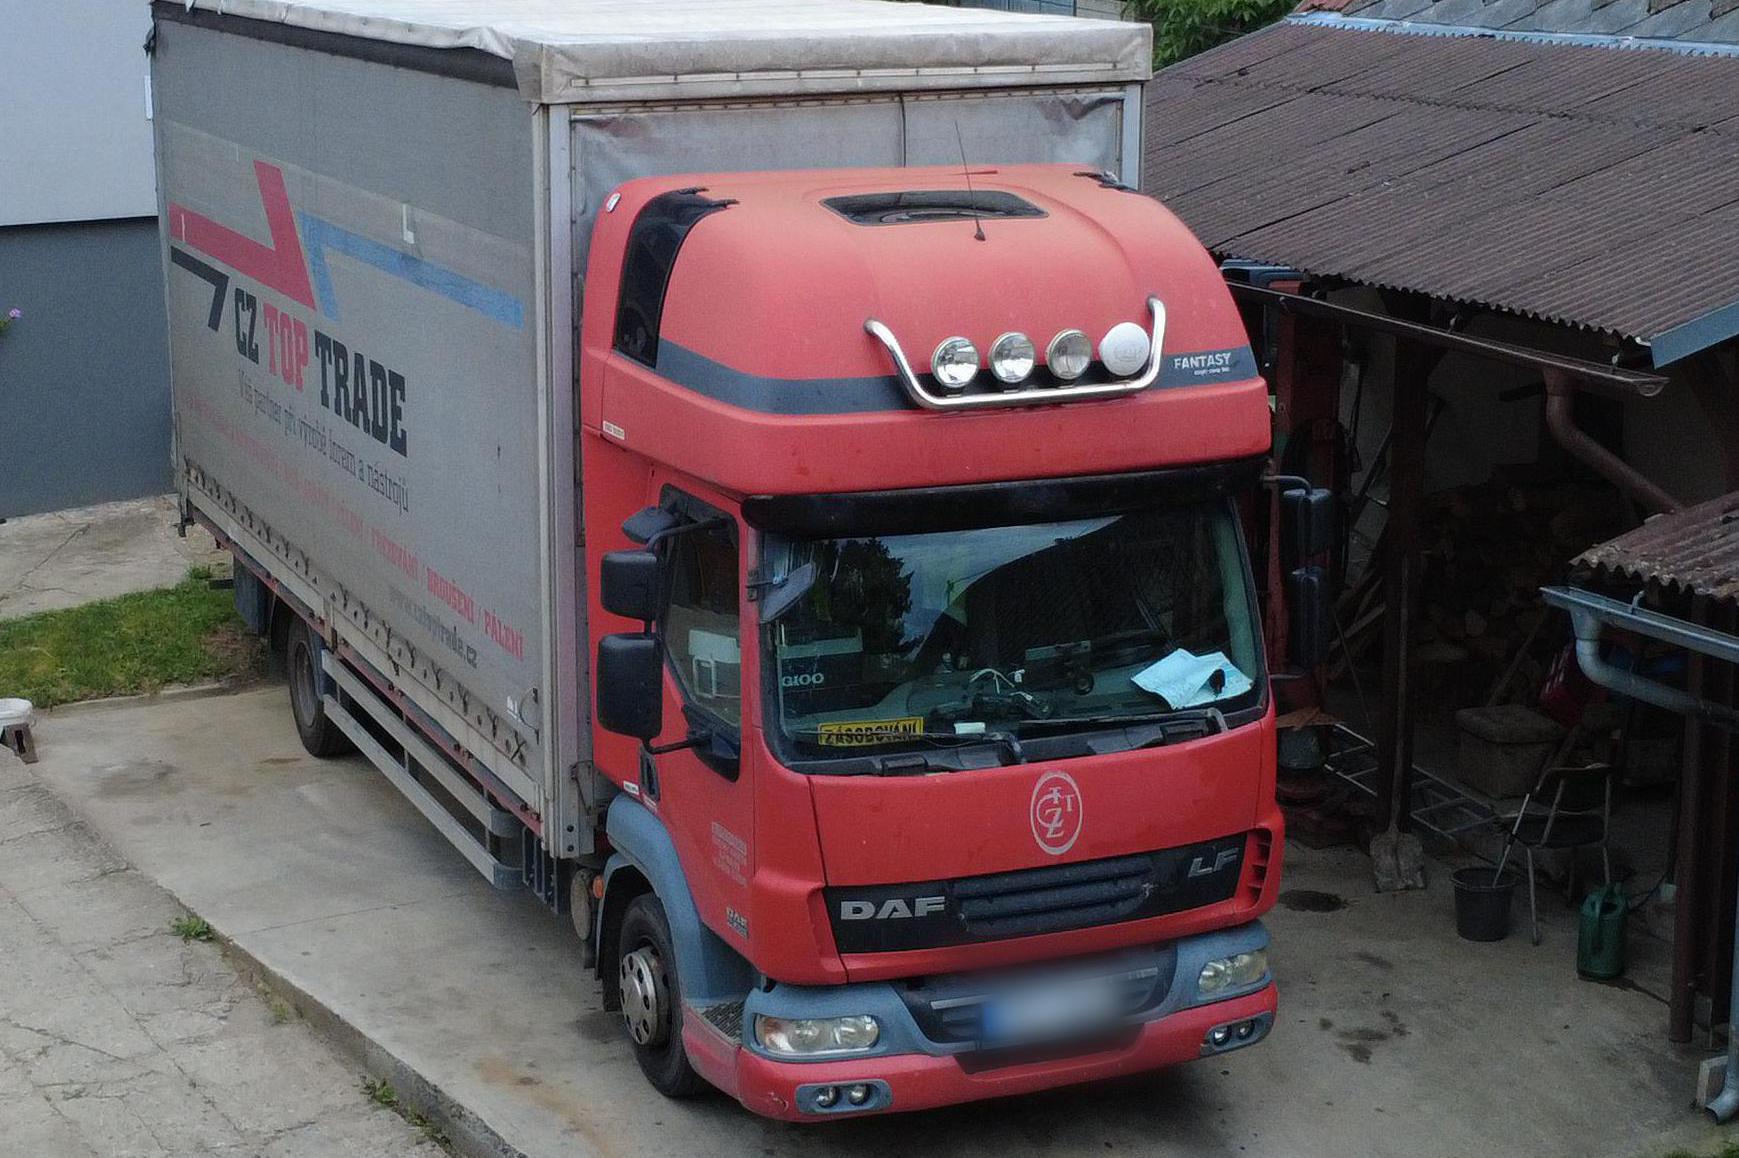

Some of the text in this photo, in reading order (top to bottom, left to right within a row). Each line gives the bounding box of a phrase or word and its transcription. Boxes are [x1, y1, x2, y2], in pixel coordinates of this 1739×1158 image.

[234, 287, 259, 365] CZ
[263, 303, 309, 392] TOP
[314, 329, 408, 458] TRADE
[1174, 351, 1231, 370] FANTASY
[1187, 847, 1239, 878] LF
[841, 896, 945, 920] DAF
